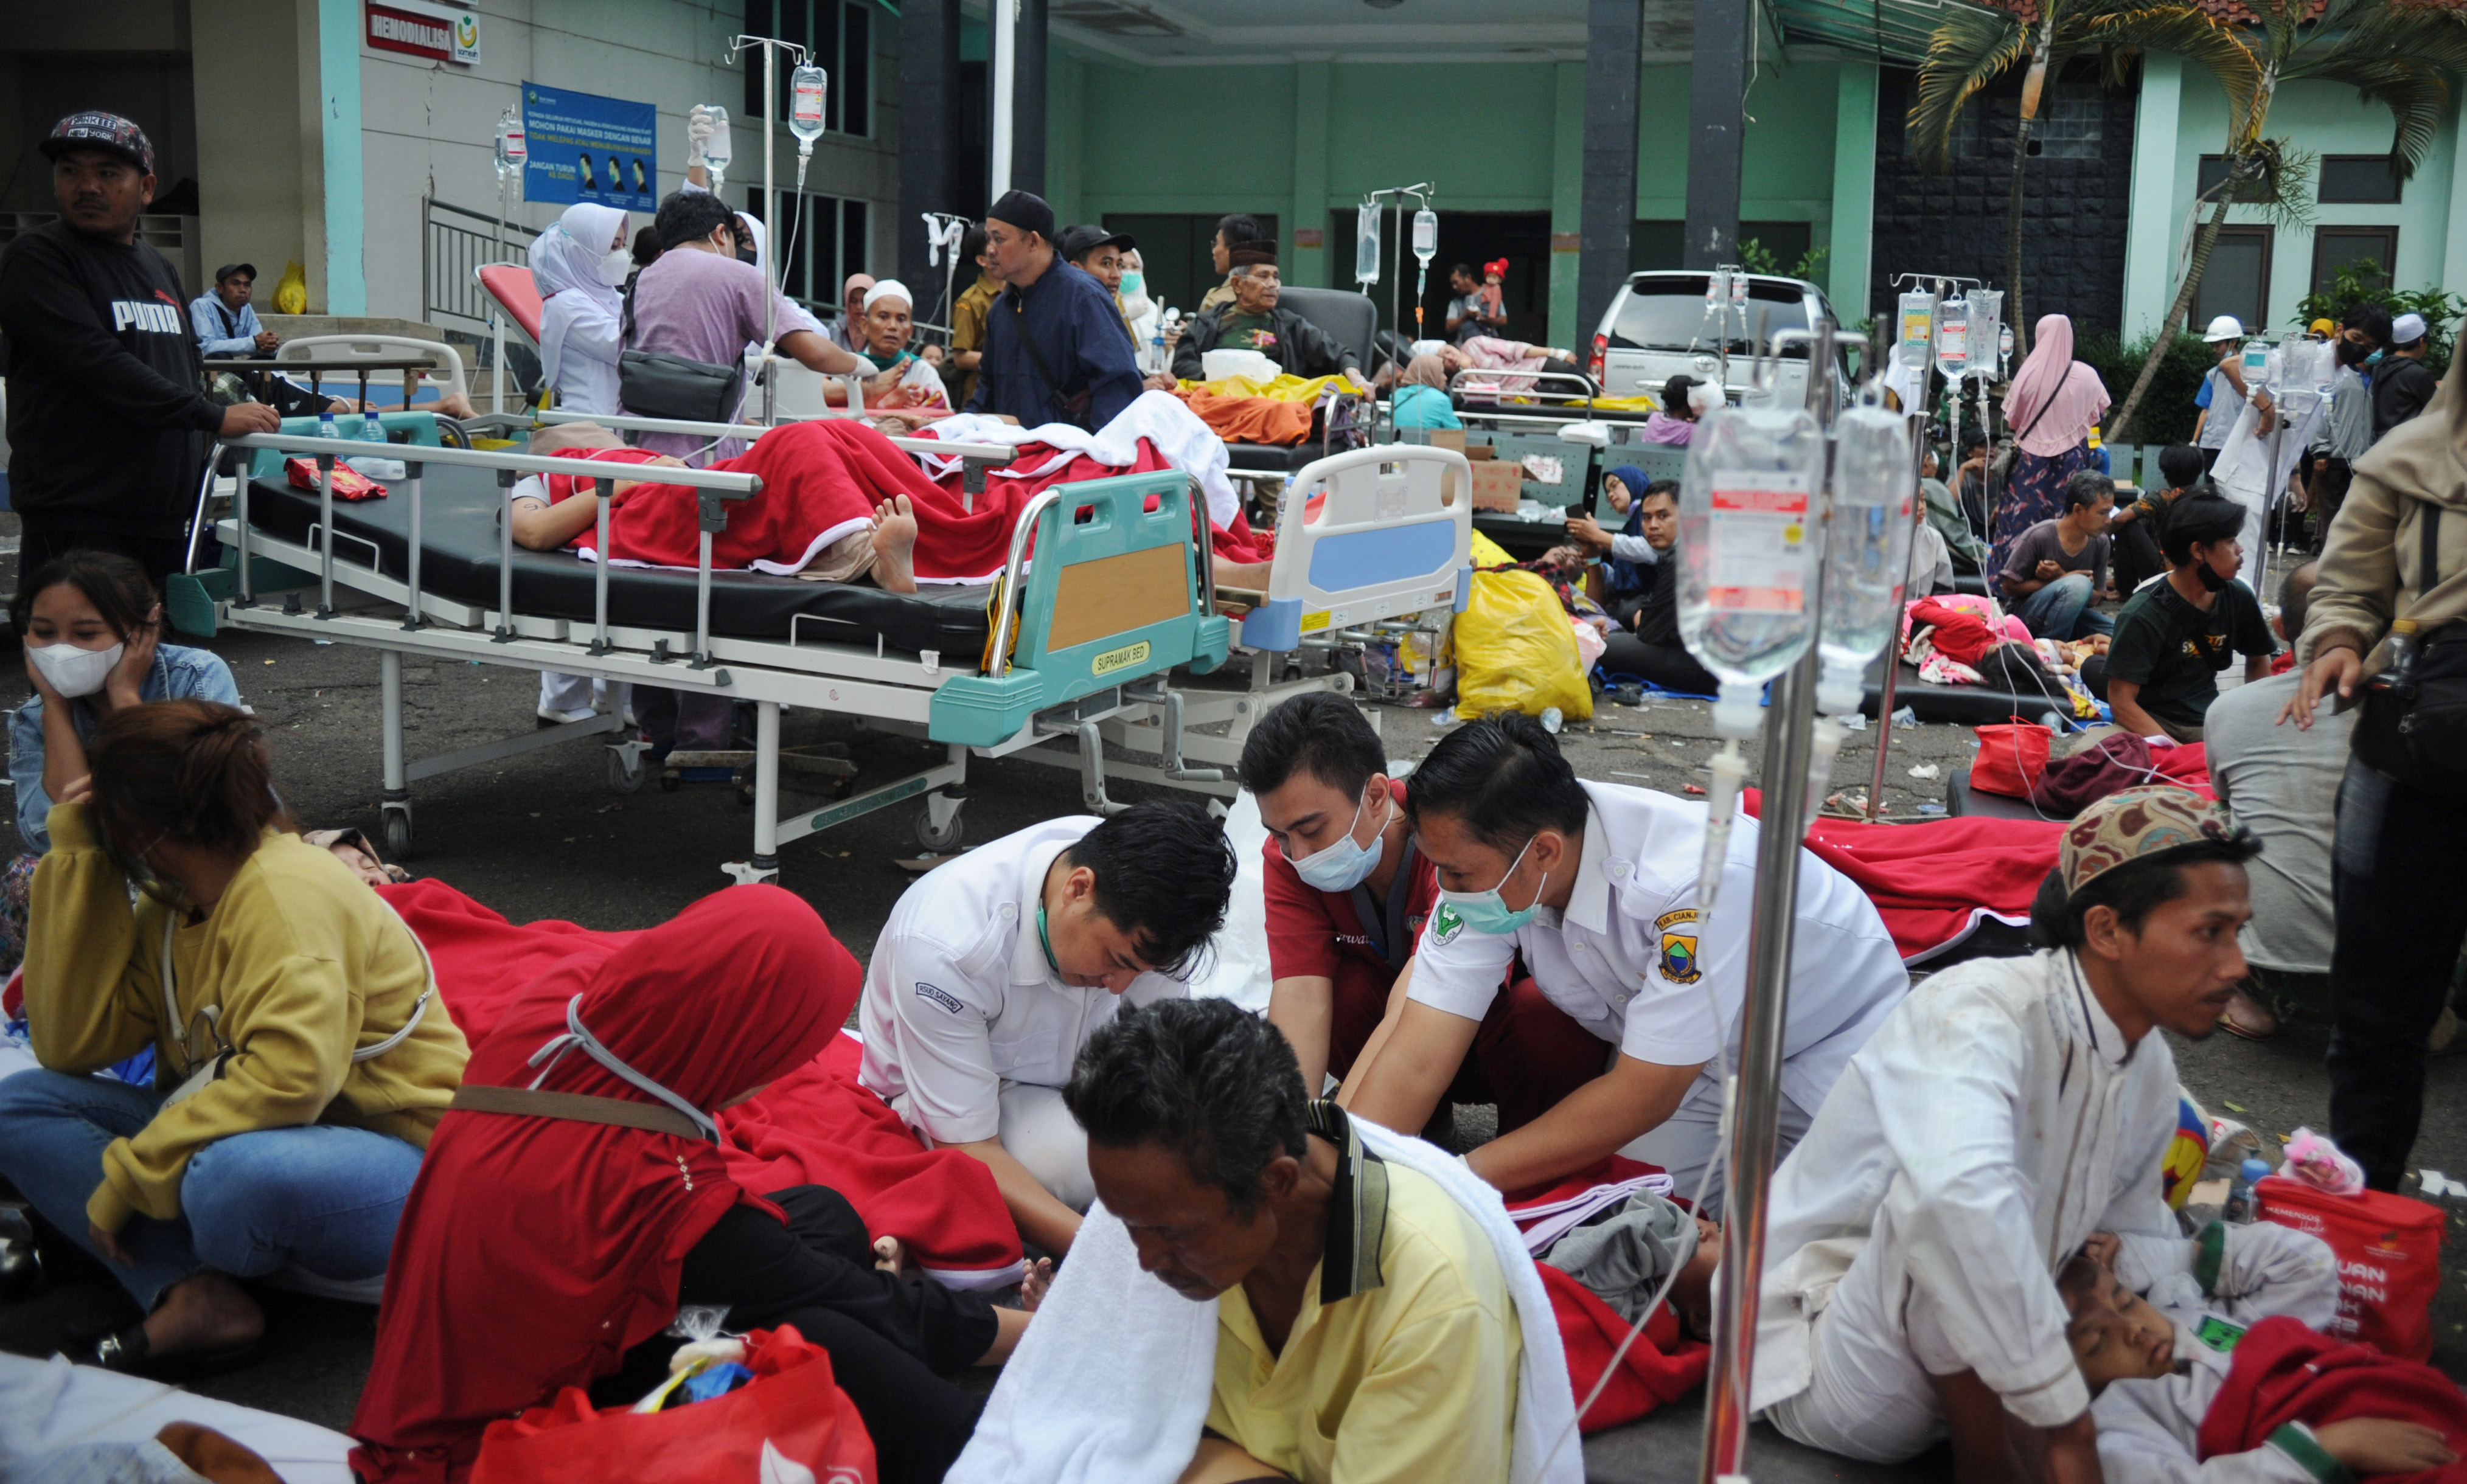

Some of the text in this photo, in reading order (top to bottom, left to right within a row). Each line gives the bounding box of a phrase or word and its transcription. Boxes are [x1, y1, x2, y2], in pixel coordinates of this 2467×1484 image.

[371, 15, 451, 52] HEMODIALISA
[70, 128, 113, 140] NEW YORK
[72, 116, 116, 129] YANKEES
[529, 119, 652, 146] MOHON PAKAI MASKER DENGAN BENAR
[529, 161, 555, 171] JANGAN
[112, 301, 181, 334] PUMA
[1098, 645, 1144, 671] SUPRAMAK BED
[919, 985, 958, 1010] RSUD SAYANG
